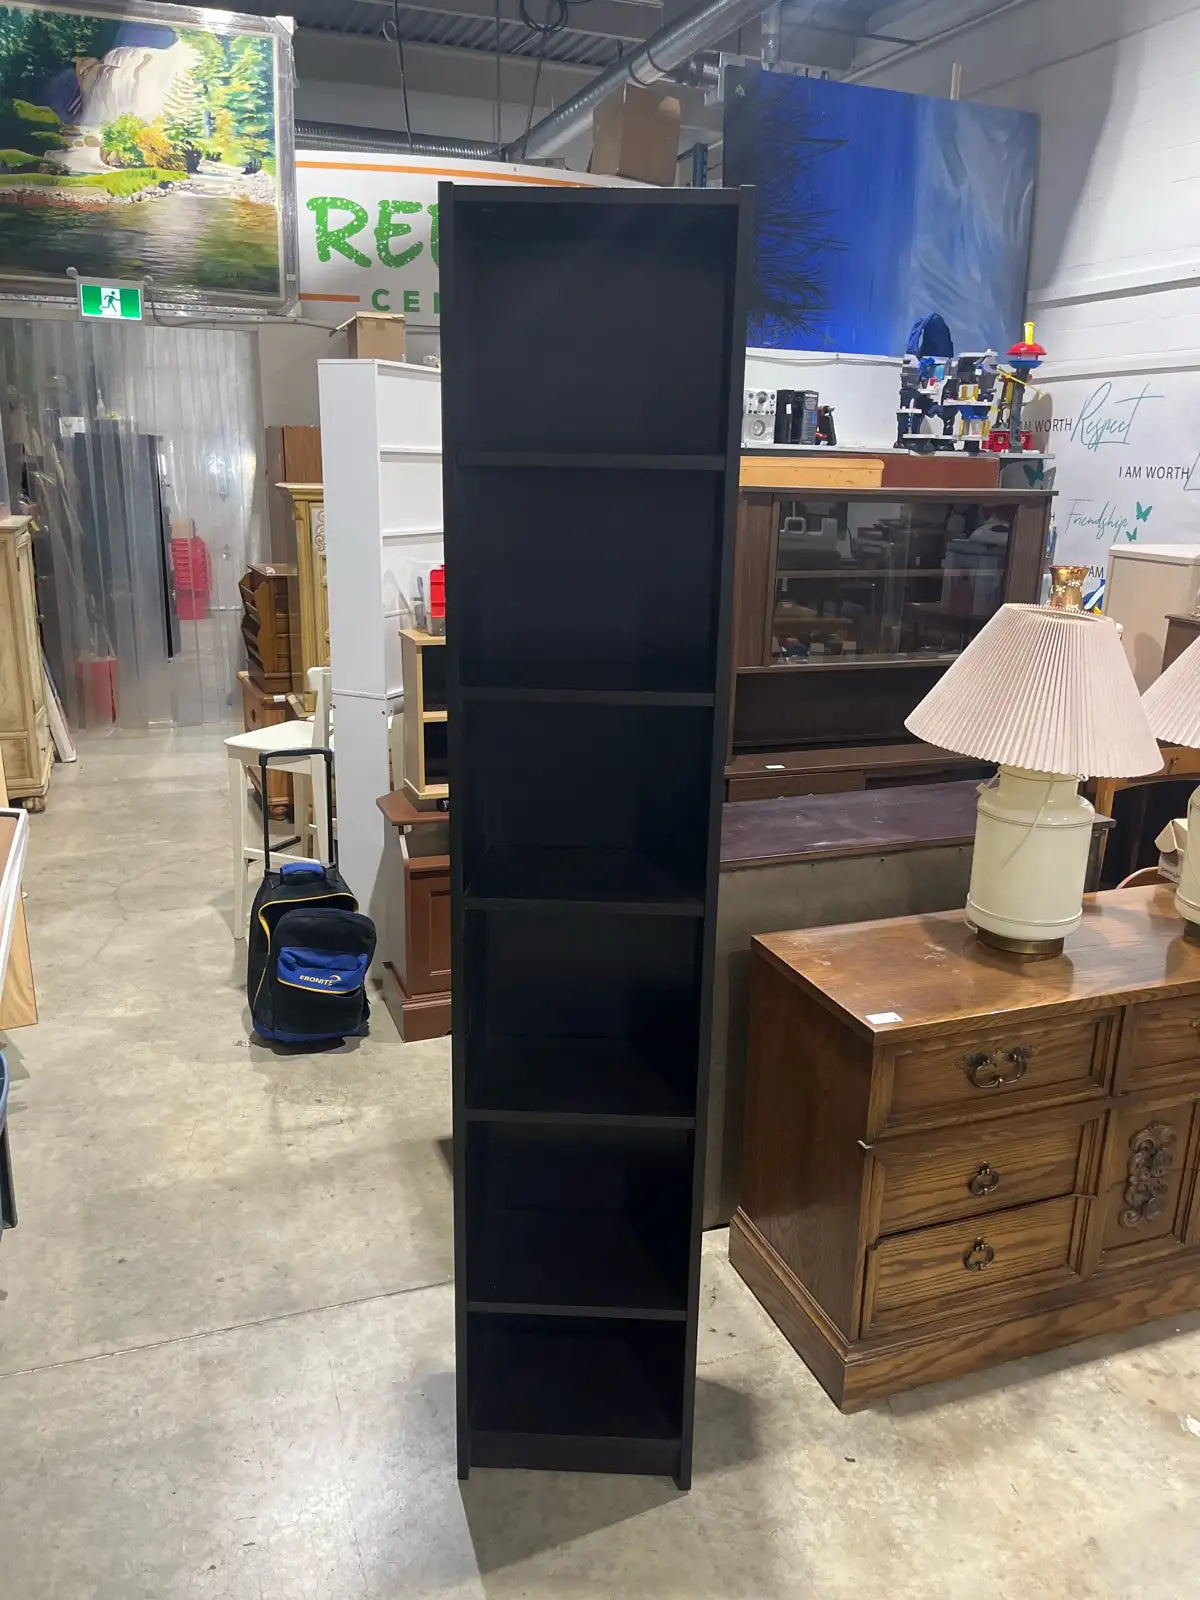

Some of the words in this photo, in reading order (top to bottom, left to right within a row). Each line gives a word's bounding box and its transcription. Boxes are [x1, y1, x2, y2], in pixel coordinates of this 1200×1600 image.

[306, 196, 439, 268] RE
[1034, 418, 1072, 433] WORTH
[1070, 381, 1165, 452] Respect
[1118, 466, 1122, 478] I
[1125, 465, 1142, 479] AM
[1146, 465, 1190, 480] WORTH
[1064, 498, 1129, 543] Friendship
[1088, 566, 1104, 578] AM
[299, 974, 333, 986] EBONITE
